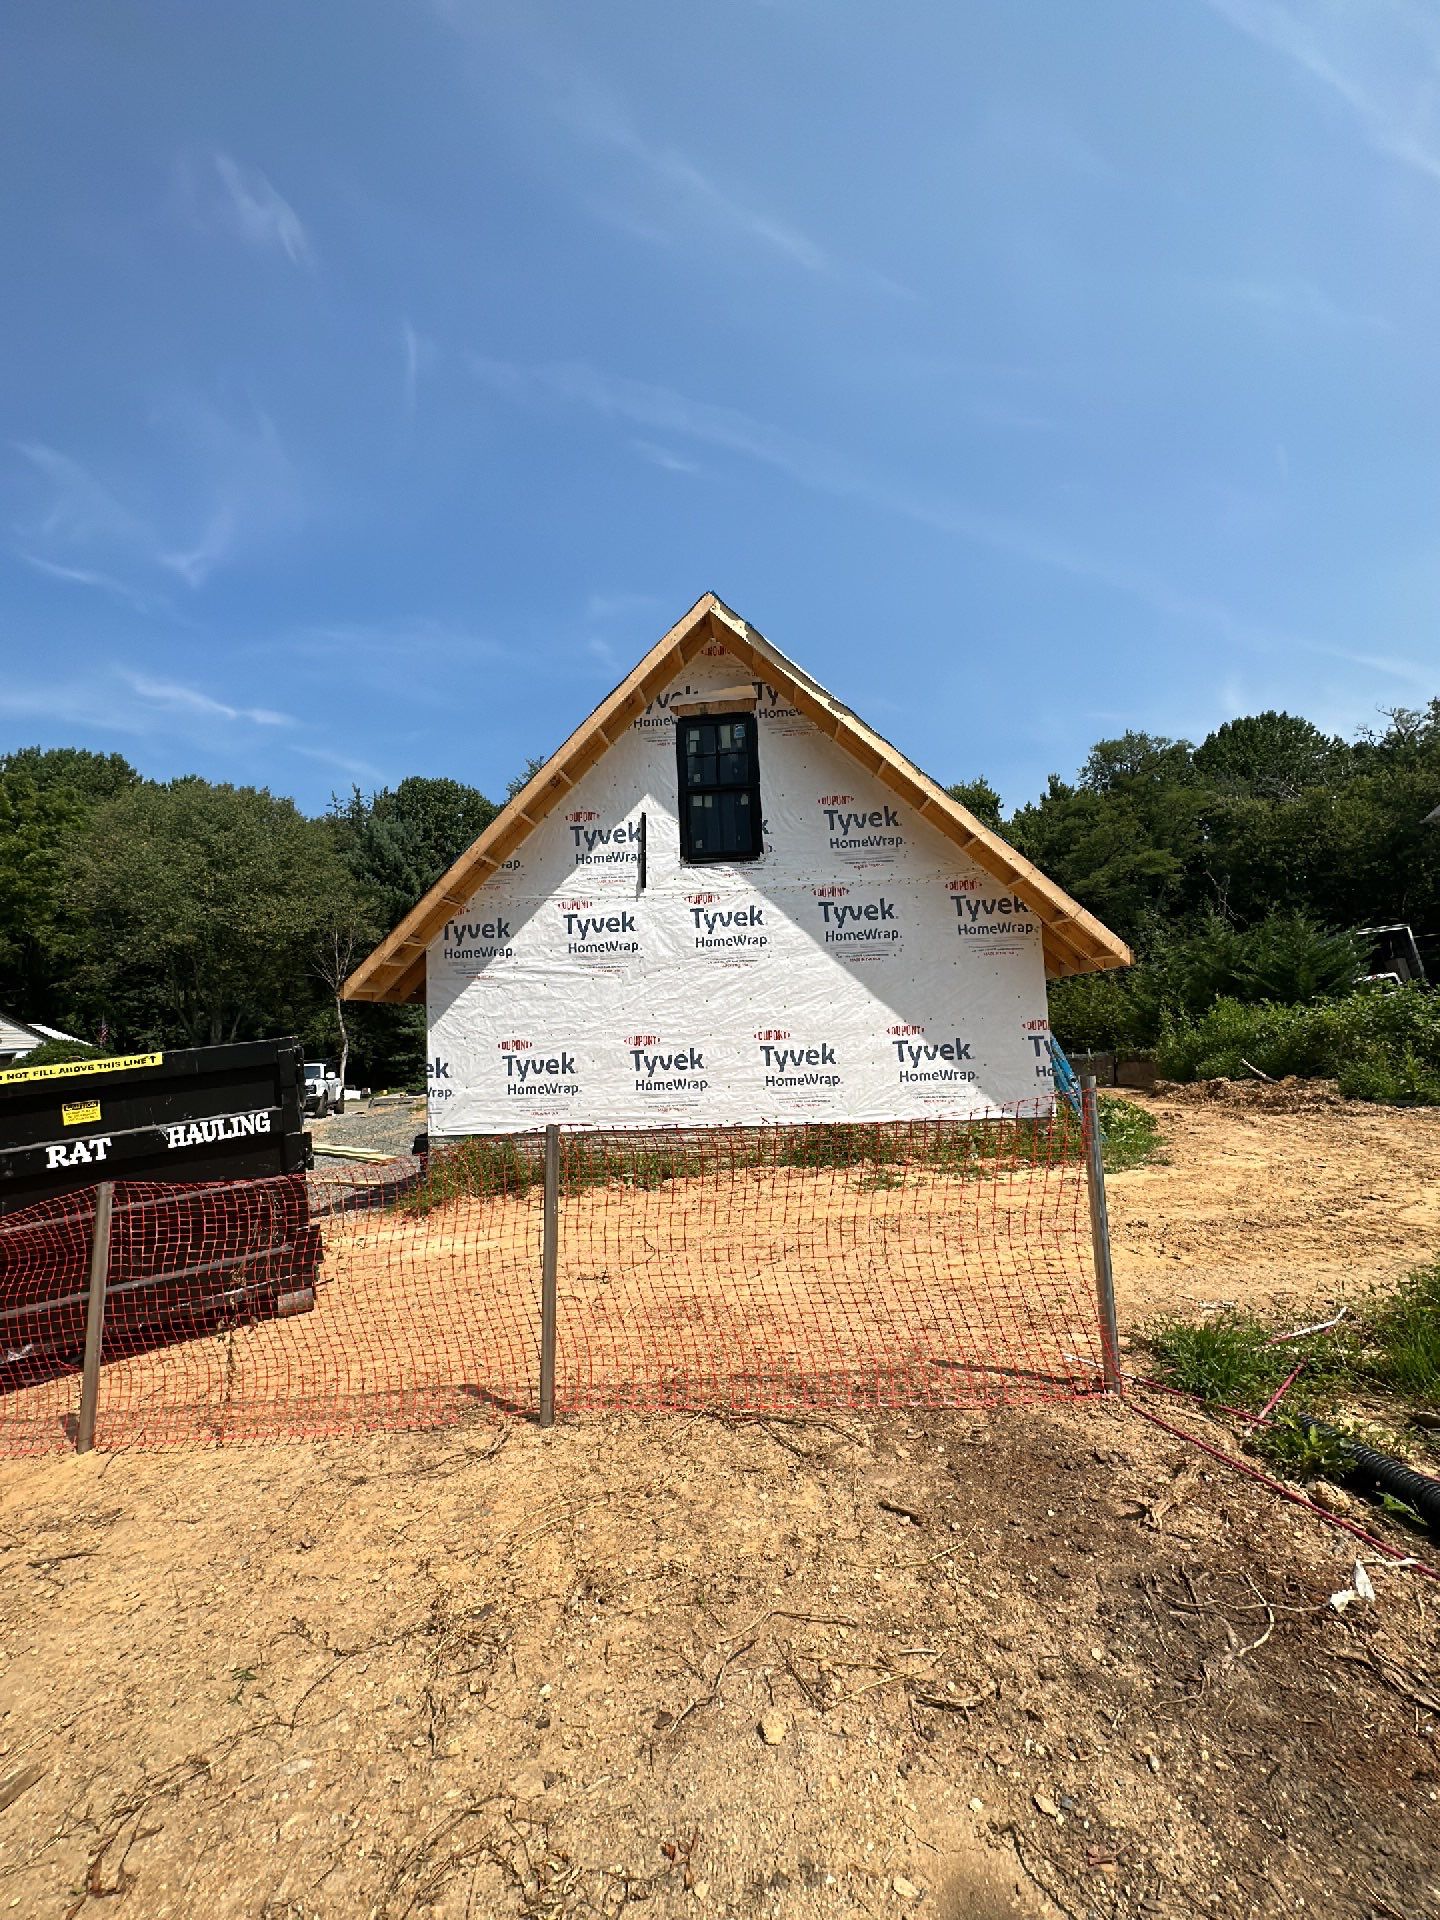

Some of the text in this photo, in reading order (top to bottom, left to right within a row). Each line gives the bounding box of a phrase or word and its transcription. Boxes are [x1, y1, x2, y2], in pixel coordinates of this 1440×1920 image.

[824, 806, 899, 835] Tyvek
[570, 822, 642, 851] Tyvek
[830, 836, 903, 849] HomeWrap
[817, 887, 847, 898] DUPONT
[690, 905, 764, 934] Tyvek
[818, 898, 896, 928] Tyvek
[951, 894, 1028, 922] Tyvek
[444, 917, 511, 946] Tyvek
[563, 911, 636, 940] Tyvek
[825, 928, 899, 942] HomeWrap
[958, 922, 1033, 935] HomeWrap
[444, 946, 513, 959] HomeWrap
[568, 941, 639, 954] HomeWrap
[695, 935, 768, 948] HomeWrap
[630, 1048, 704, 1077] Tyvek
[760, 1043, 836, 1072] Tyvek
[892, 1038, 972, 1068] Tyvek
[7, 1072, 29, 1080] NOT
[33, 1069, 56, 1077] FILL
[58, 1064, 95, 1074] ABOVE
[98, 1062, 121, 1070] THIS
[124, 1058, 147, 1067] LINE
[502, 1052, 576, 1081] Tyvek
[899, 1069, 976, 1082] HomeWrap
[507, 1083, 579, 1097] HomeWrap
[635, 1078, 708, 1091] HomeWrap
[765, 1073, 841, 1087] HomeWrap
[46, 1111, 271, 1169] RAT HAULING
